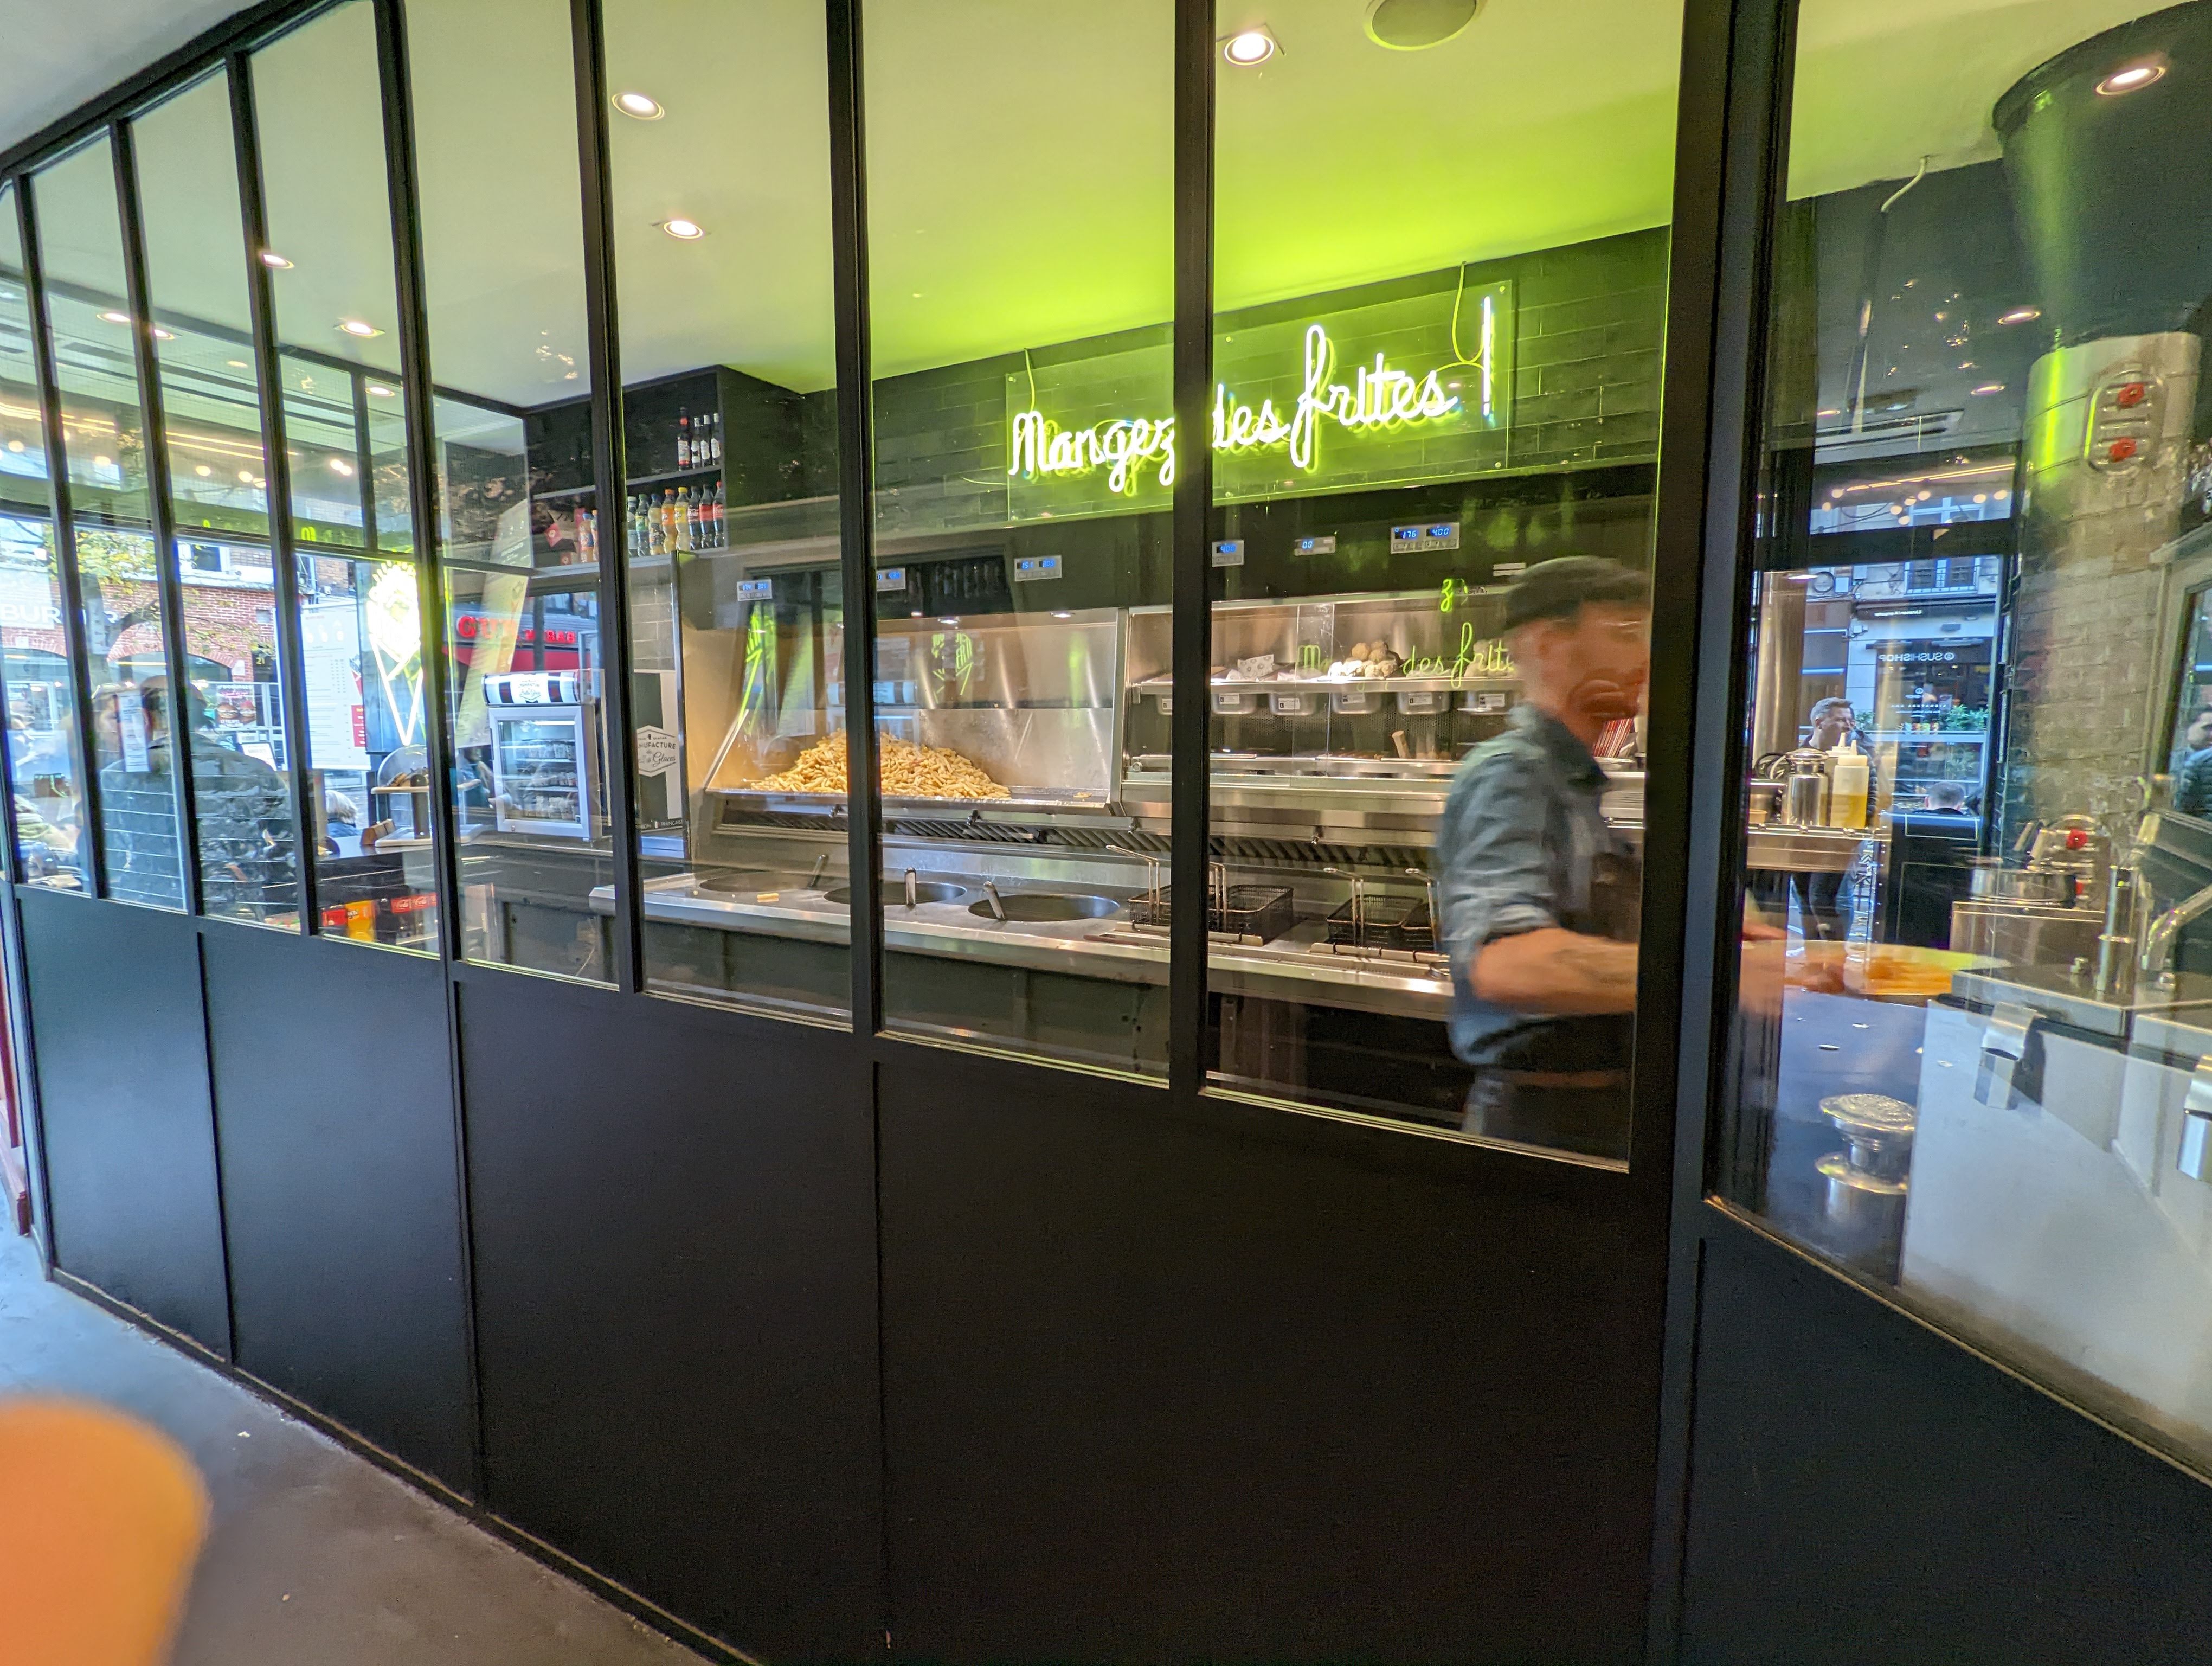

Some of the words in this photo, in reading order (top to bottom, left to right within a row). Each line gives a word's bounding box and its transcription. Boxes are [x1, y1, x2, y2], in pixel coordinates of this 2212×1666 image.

[1008, 411, 1175, 492] Mangez
[1290, 324, 1458, 468] frites
[1483, 296, 1491, 416] !
[638, 741, 676, 749] NUFACTURE
